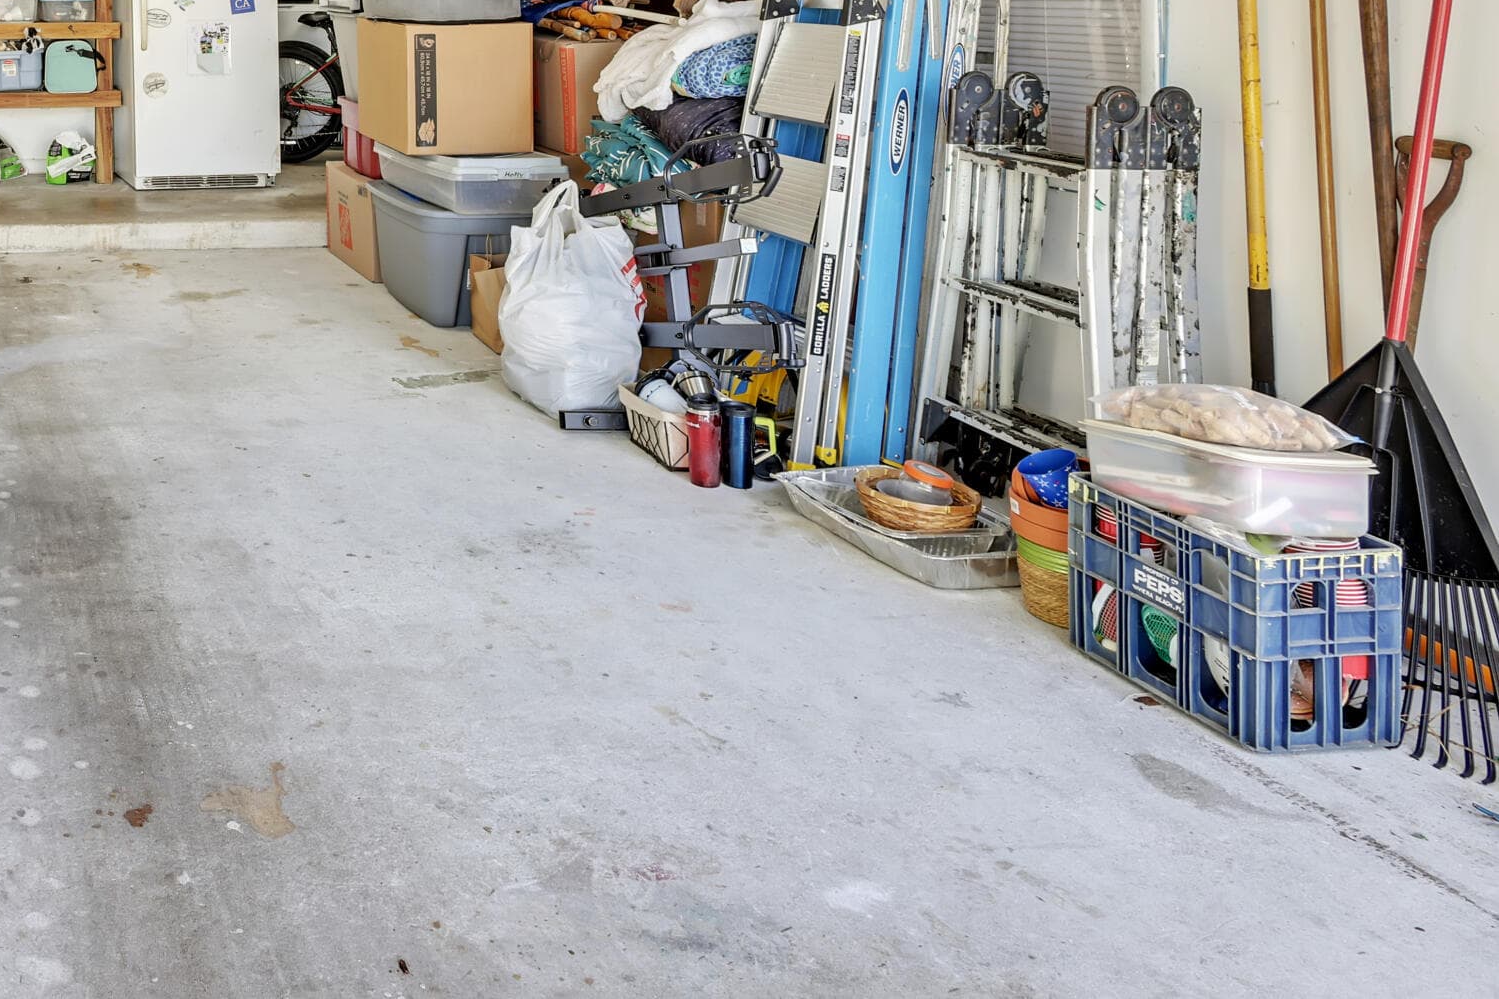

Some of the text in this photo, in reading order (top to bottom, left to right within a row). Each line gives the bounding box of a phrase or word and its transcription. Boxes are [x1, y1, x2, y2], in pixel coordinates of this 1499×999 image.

[893, 105, 906, 157] WERNER
[813, 257, 833, 355] GORILLA LADDERS
